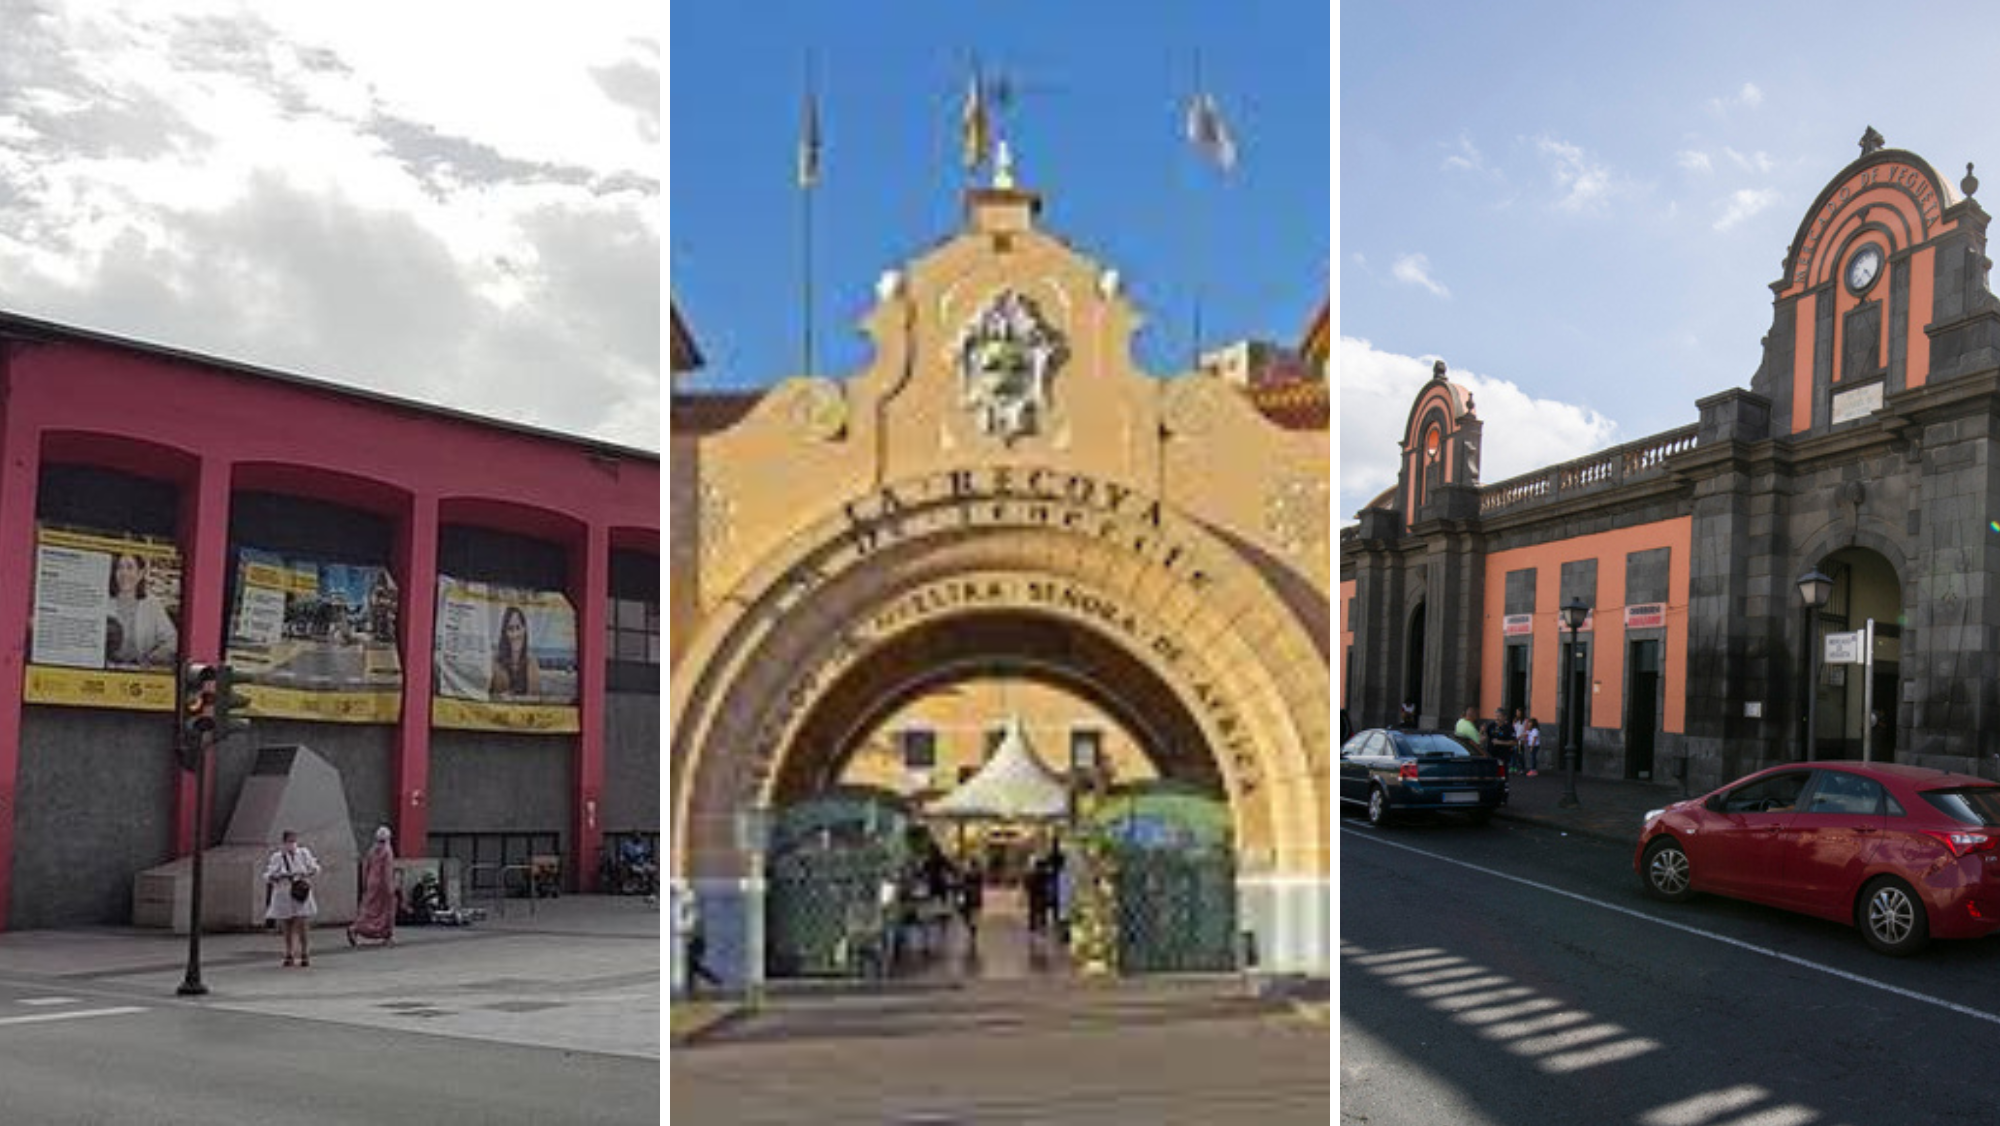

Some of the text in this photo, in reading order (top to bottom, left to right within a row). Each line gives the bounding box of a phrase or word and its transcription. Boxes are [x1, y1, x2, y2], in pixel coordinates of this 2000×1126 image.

[1795, 166, 1940, 282] MERCADO DE VEGUETA
